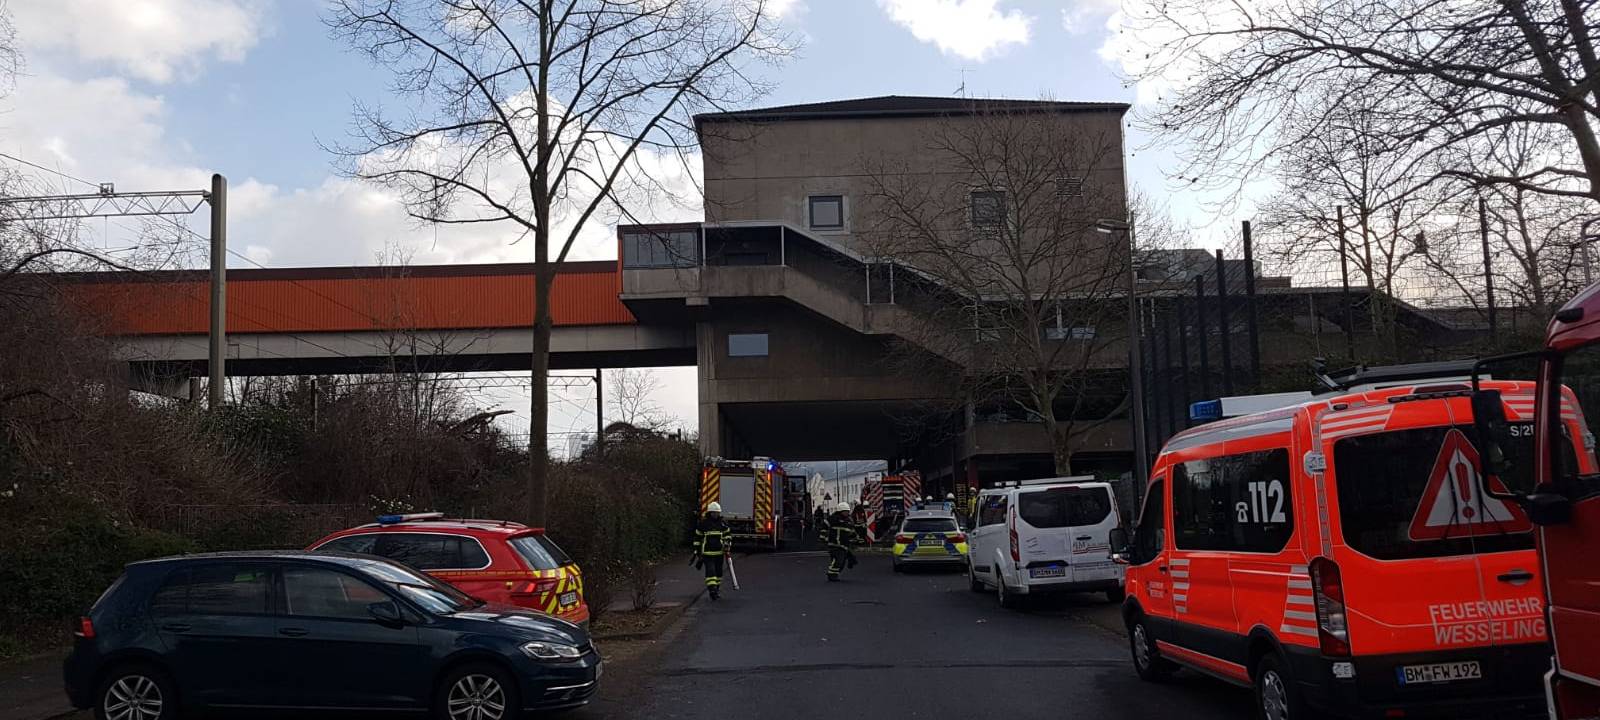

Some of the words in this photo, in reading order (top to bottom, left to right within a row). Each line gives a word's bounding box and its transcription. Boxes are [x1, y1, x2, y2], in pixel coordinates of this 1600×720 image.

[1248, 479, 1286, 523] 112
[1428, 597, 1543, 621] FEUERWEHR
[1435, 619, 1545, 645] WESSELING
[1405, 666, 1425, 681] BM
[1432, 665, 1450, 680] FW
[1454, 663, 1479, 678] 192
